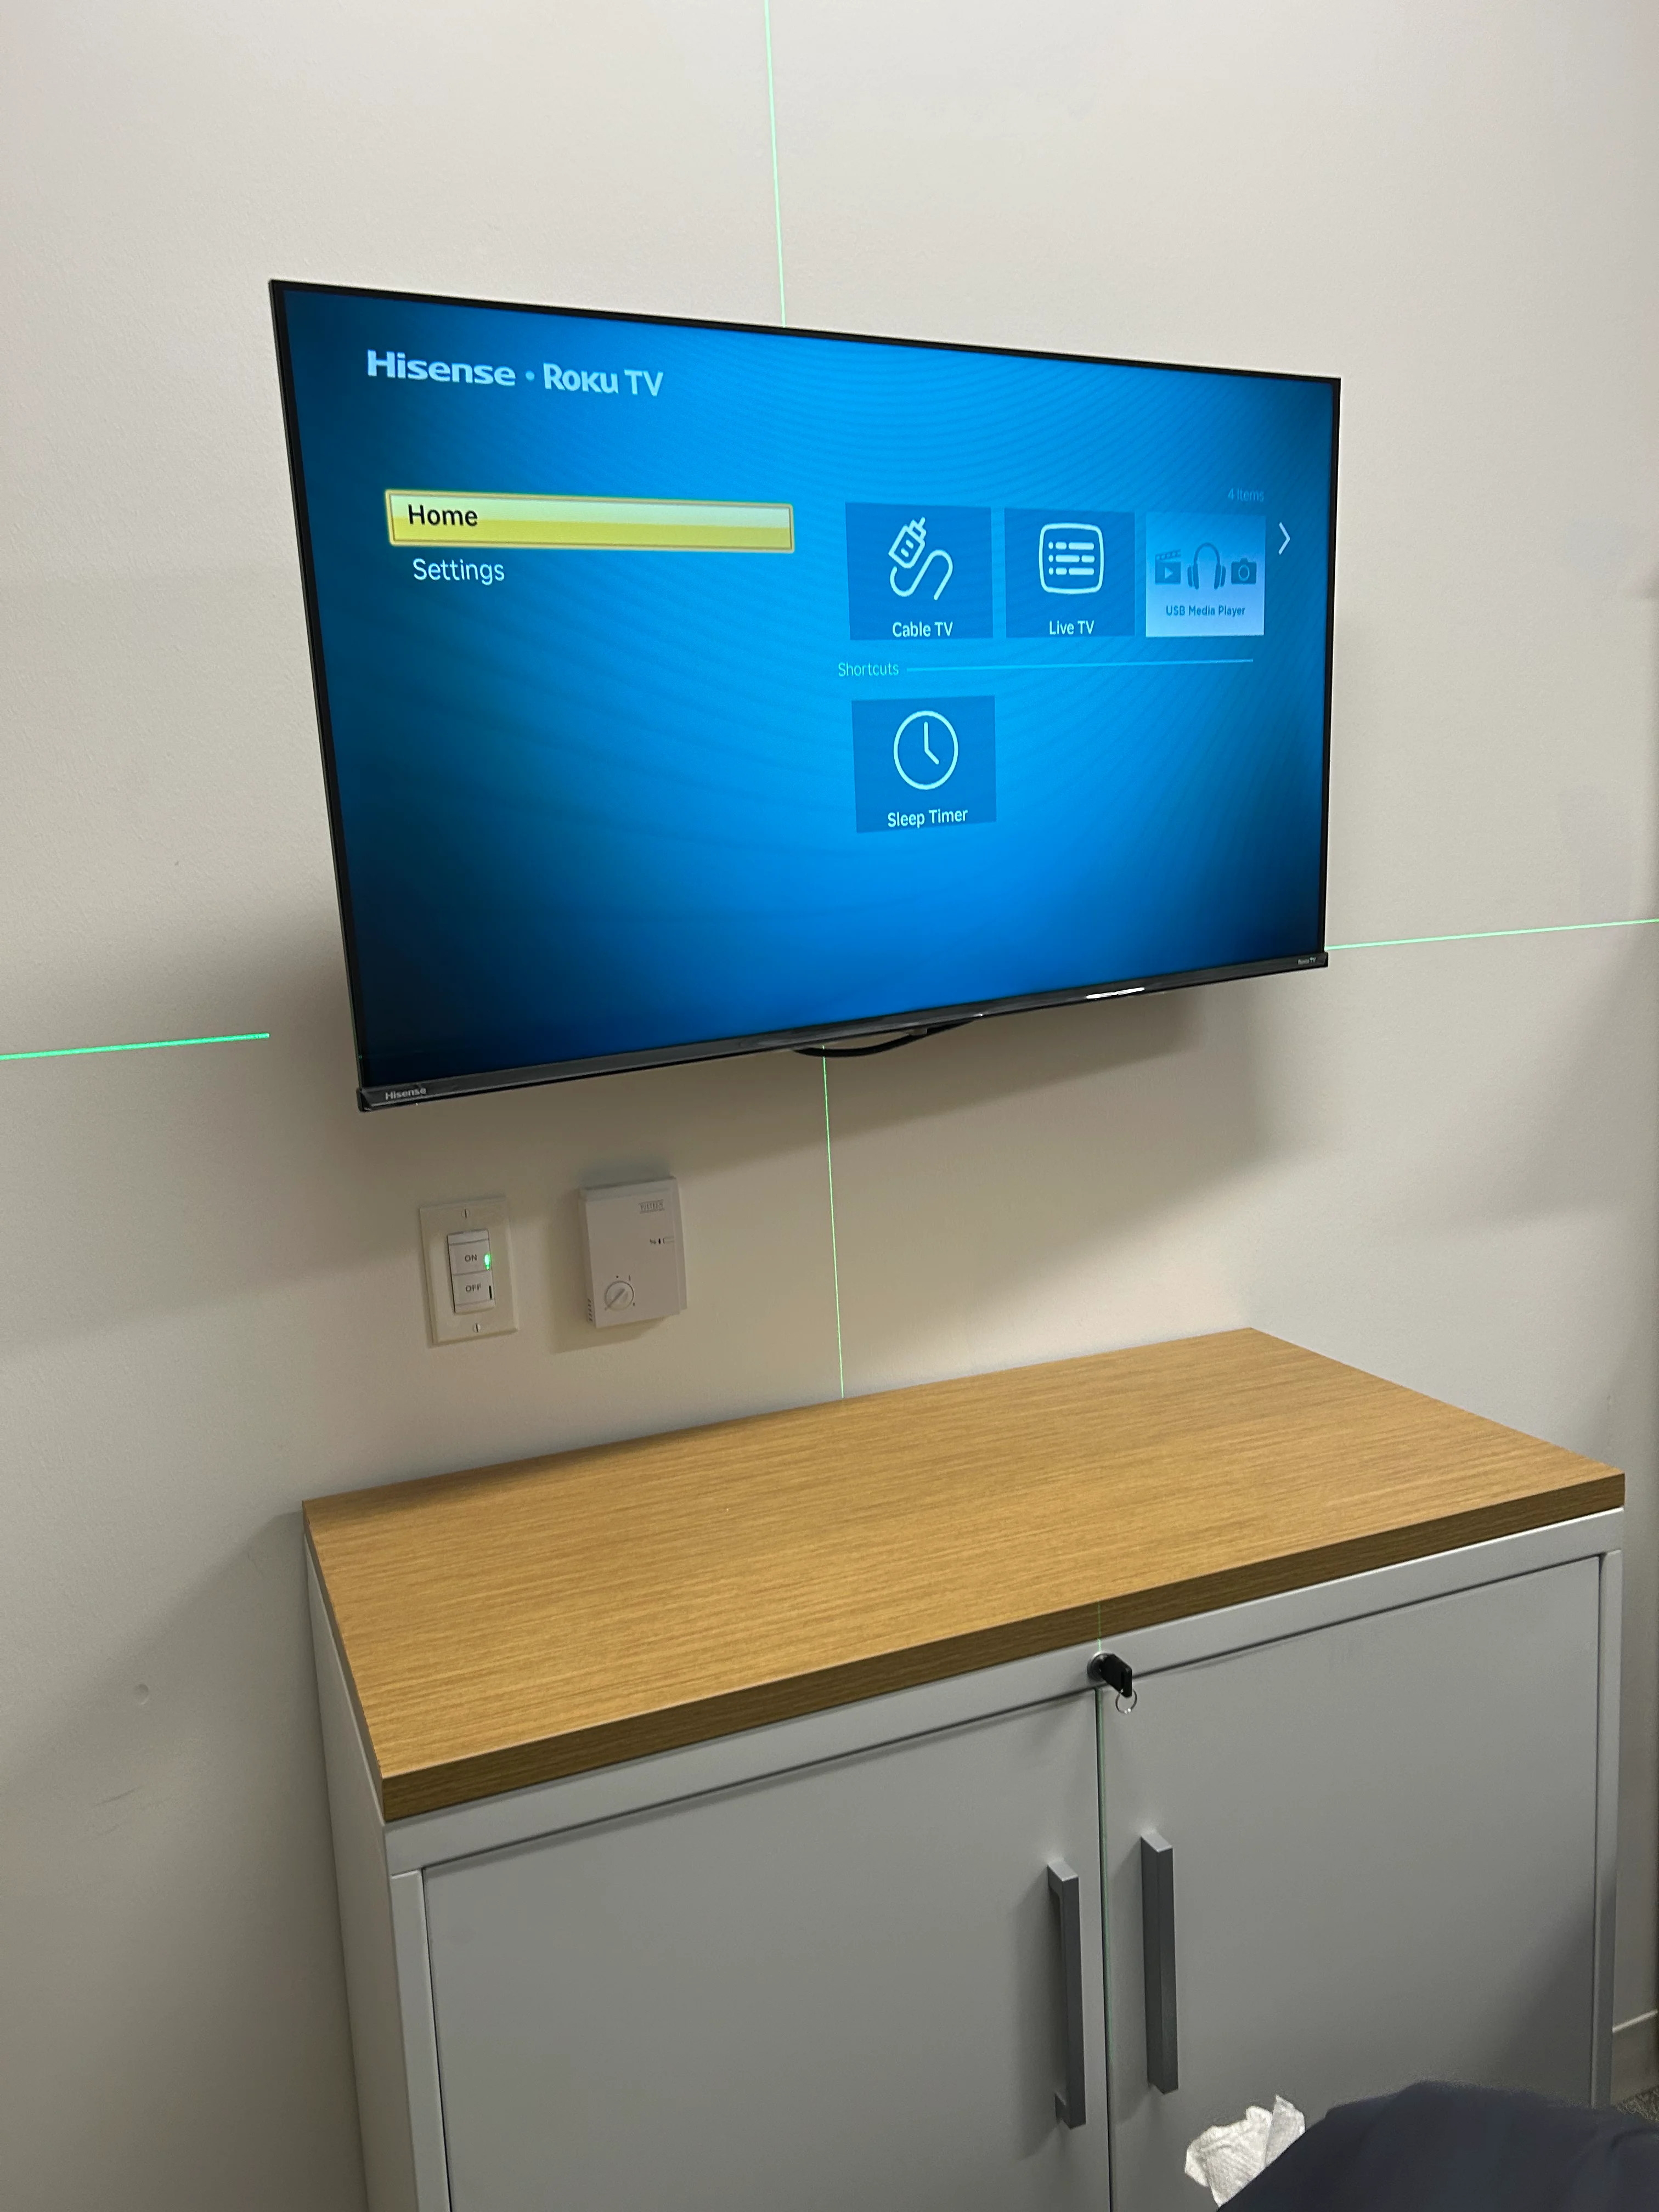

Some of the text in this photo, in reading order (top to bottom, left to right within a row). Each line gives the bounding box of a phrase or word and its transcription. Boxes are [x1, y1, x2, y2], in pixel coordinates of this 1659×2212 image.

[367, 349, 663, 397] Hisense Roku TV
[1228, 488, 1234, 500] 4
[408, 504, 478, 527] Home
[413, 558, 505, 586] Settings
[1166, 605, 1245, 617] USB Media Player
[892, 621, 953, 637] Cable TV
[1049, 620, 1094, 635] Live TV
[838, 662, 899, 677] Shortcuts
[888, 808, 968, 829] Sleep Timer
[385, 1087, 426, 1100] Hisense
[465, 1283, 481, 1293] OFF
